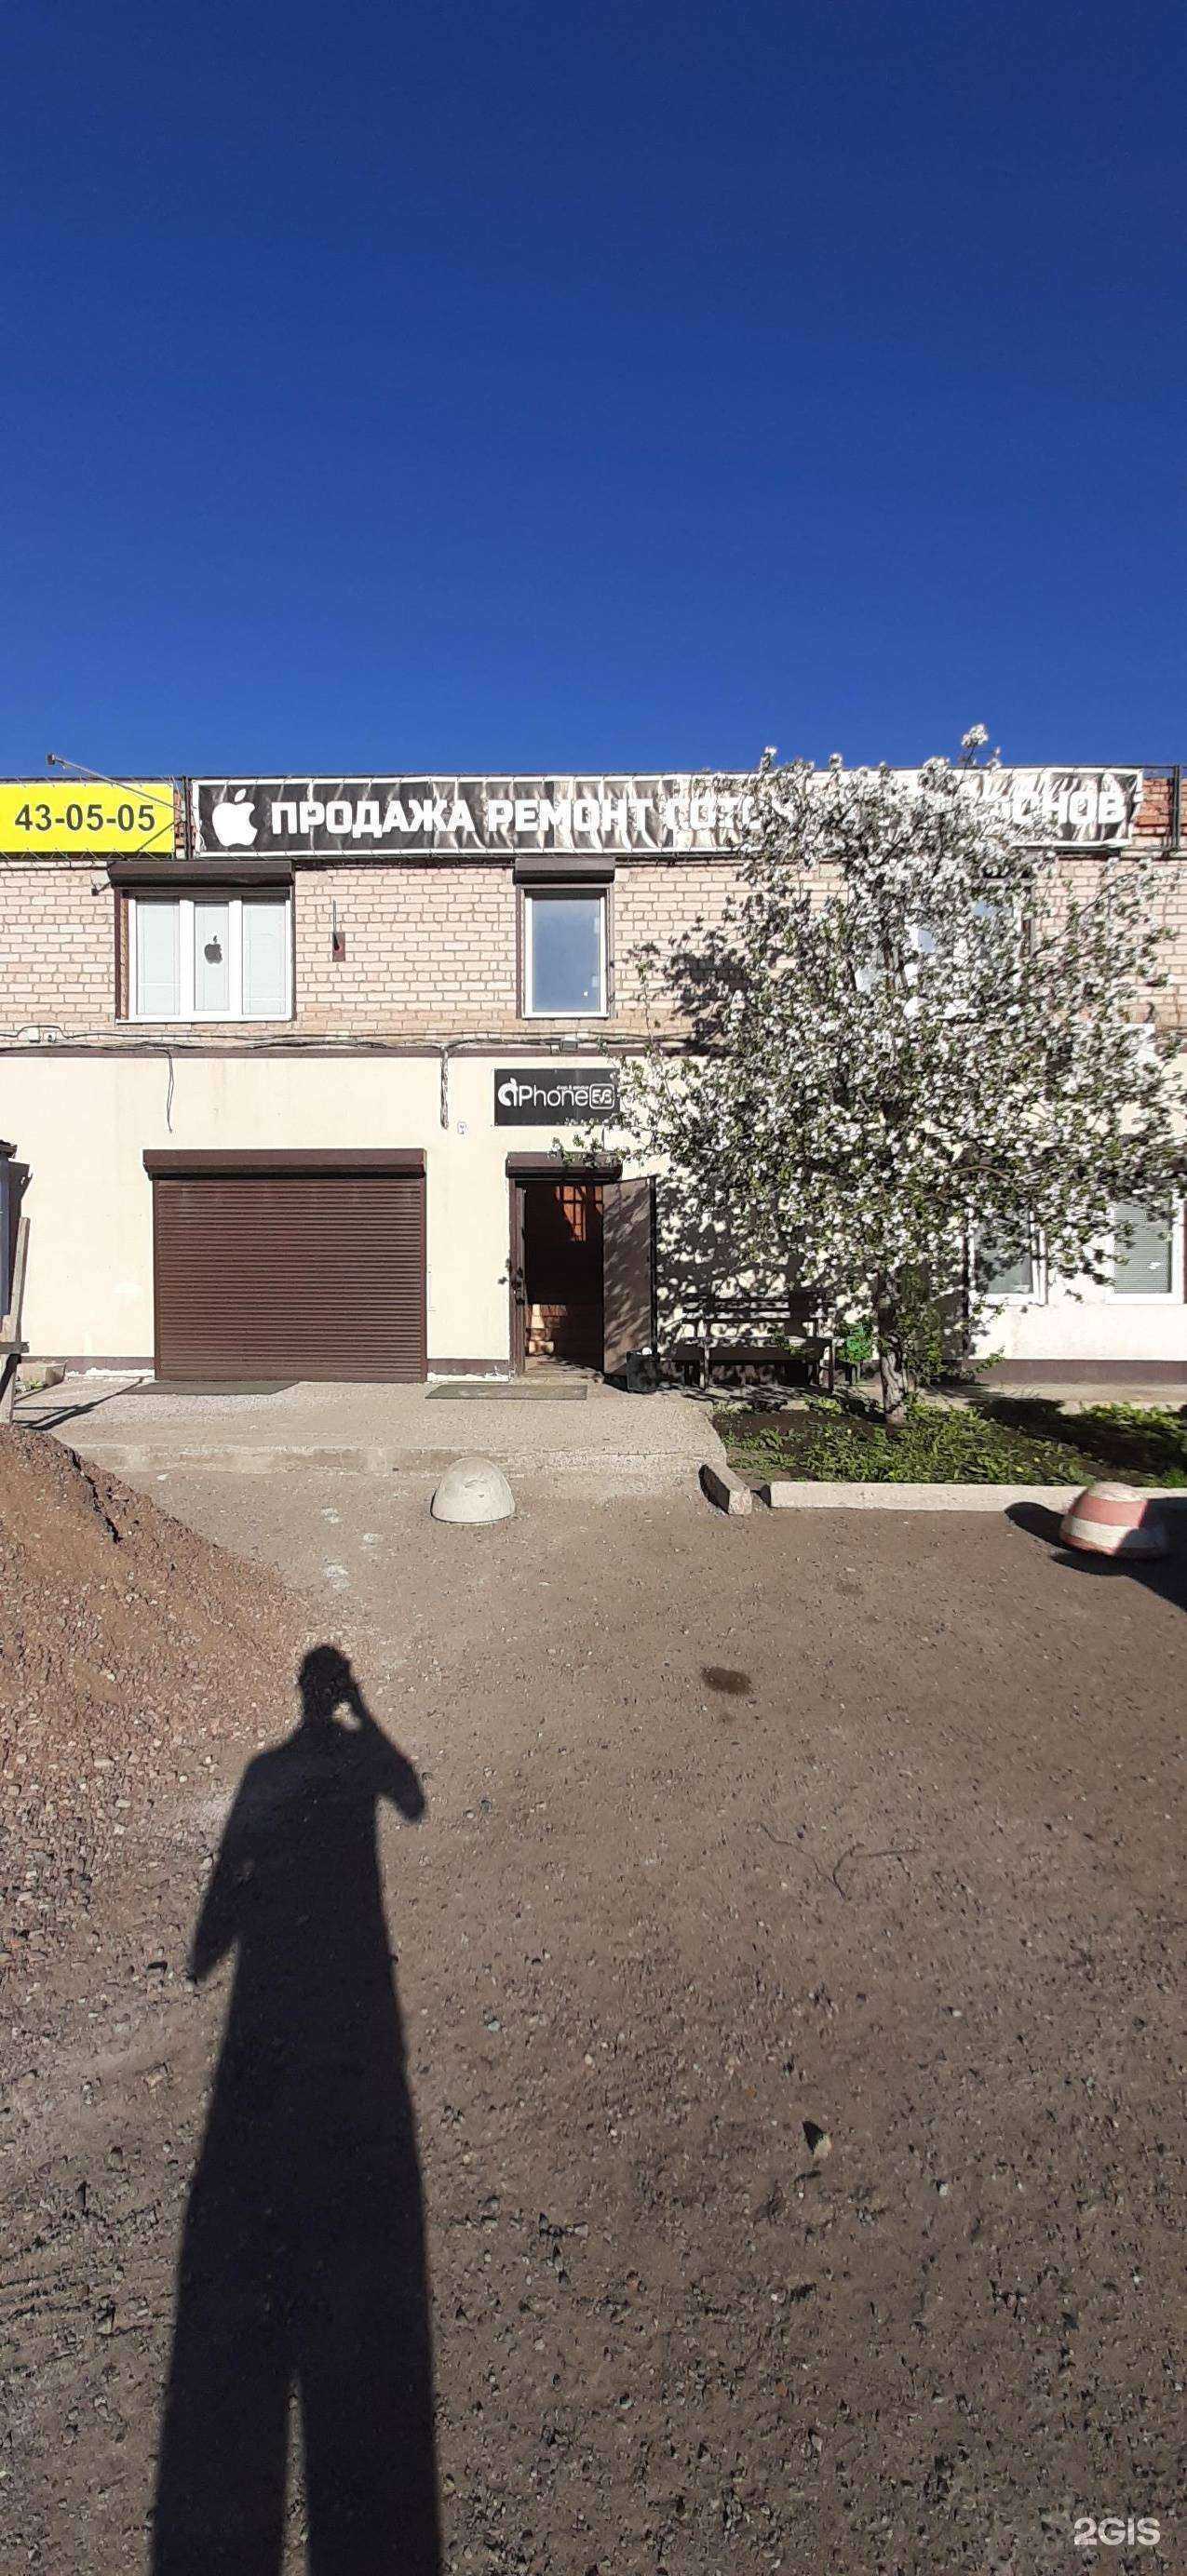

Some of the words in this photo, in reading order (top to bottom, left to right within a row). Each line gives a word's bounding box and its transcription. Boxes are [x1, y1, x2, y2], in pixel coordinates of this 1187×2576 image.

[14, 803, 155, 832] 43-05-05
[271, 798, 476, 839] ПРОДАЖА
[488, 798, 654, 832] РЕМОНТ
